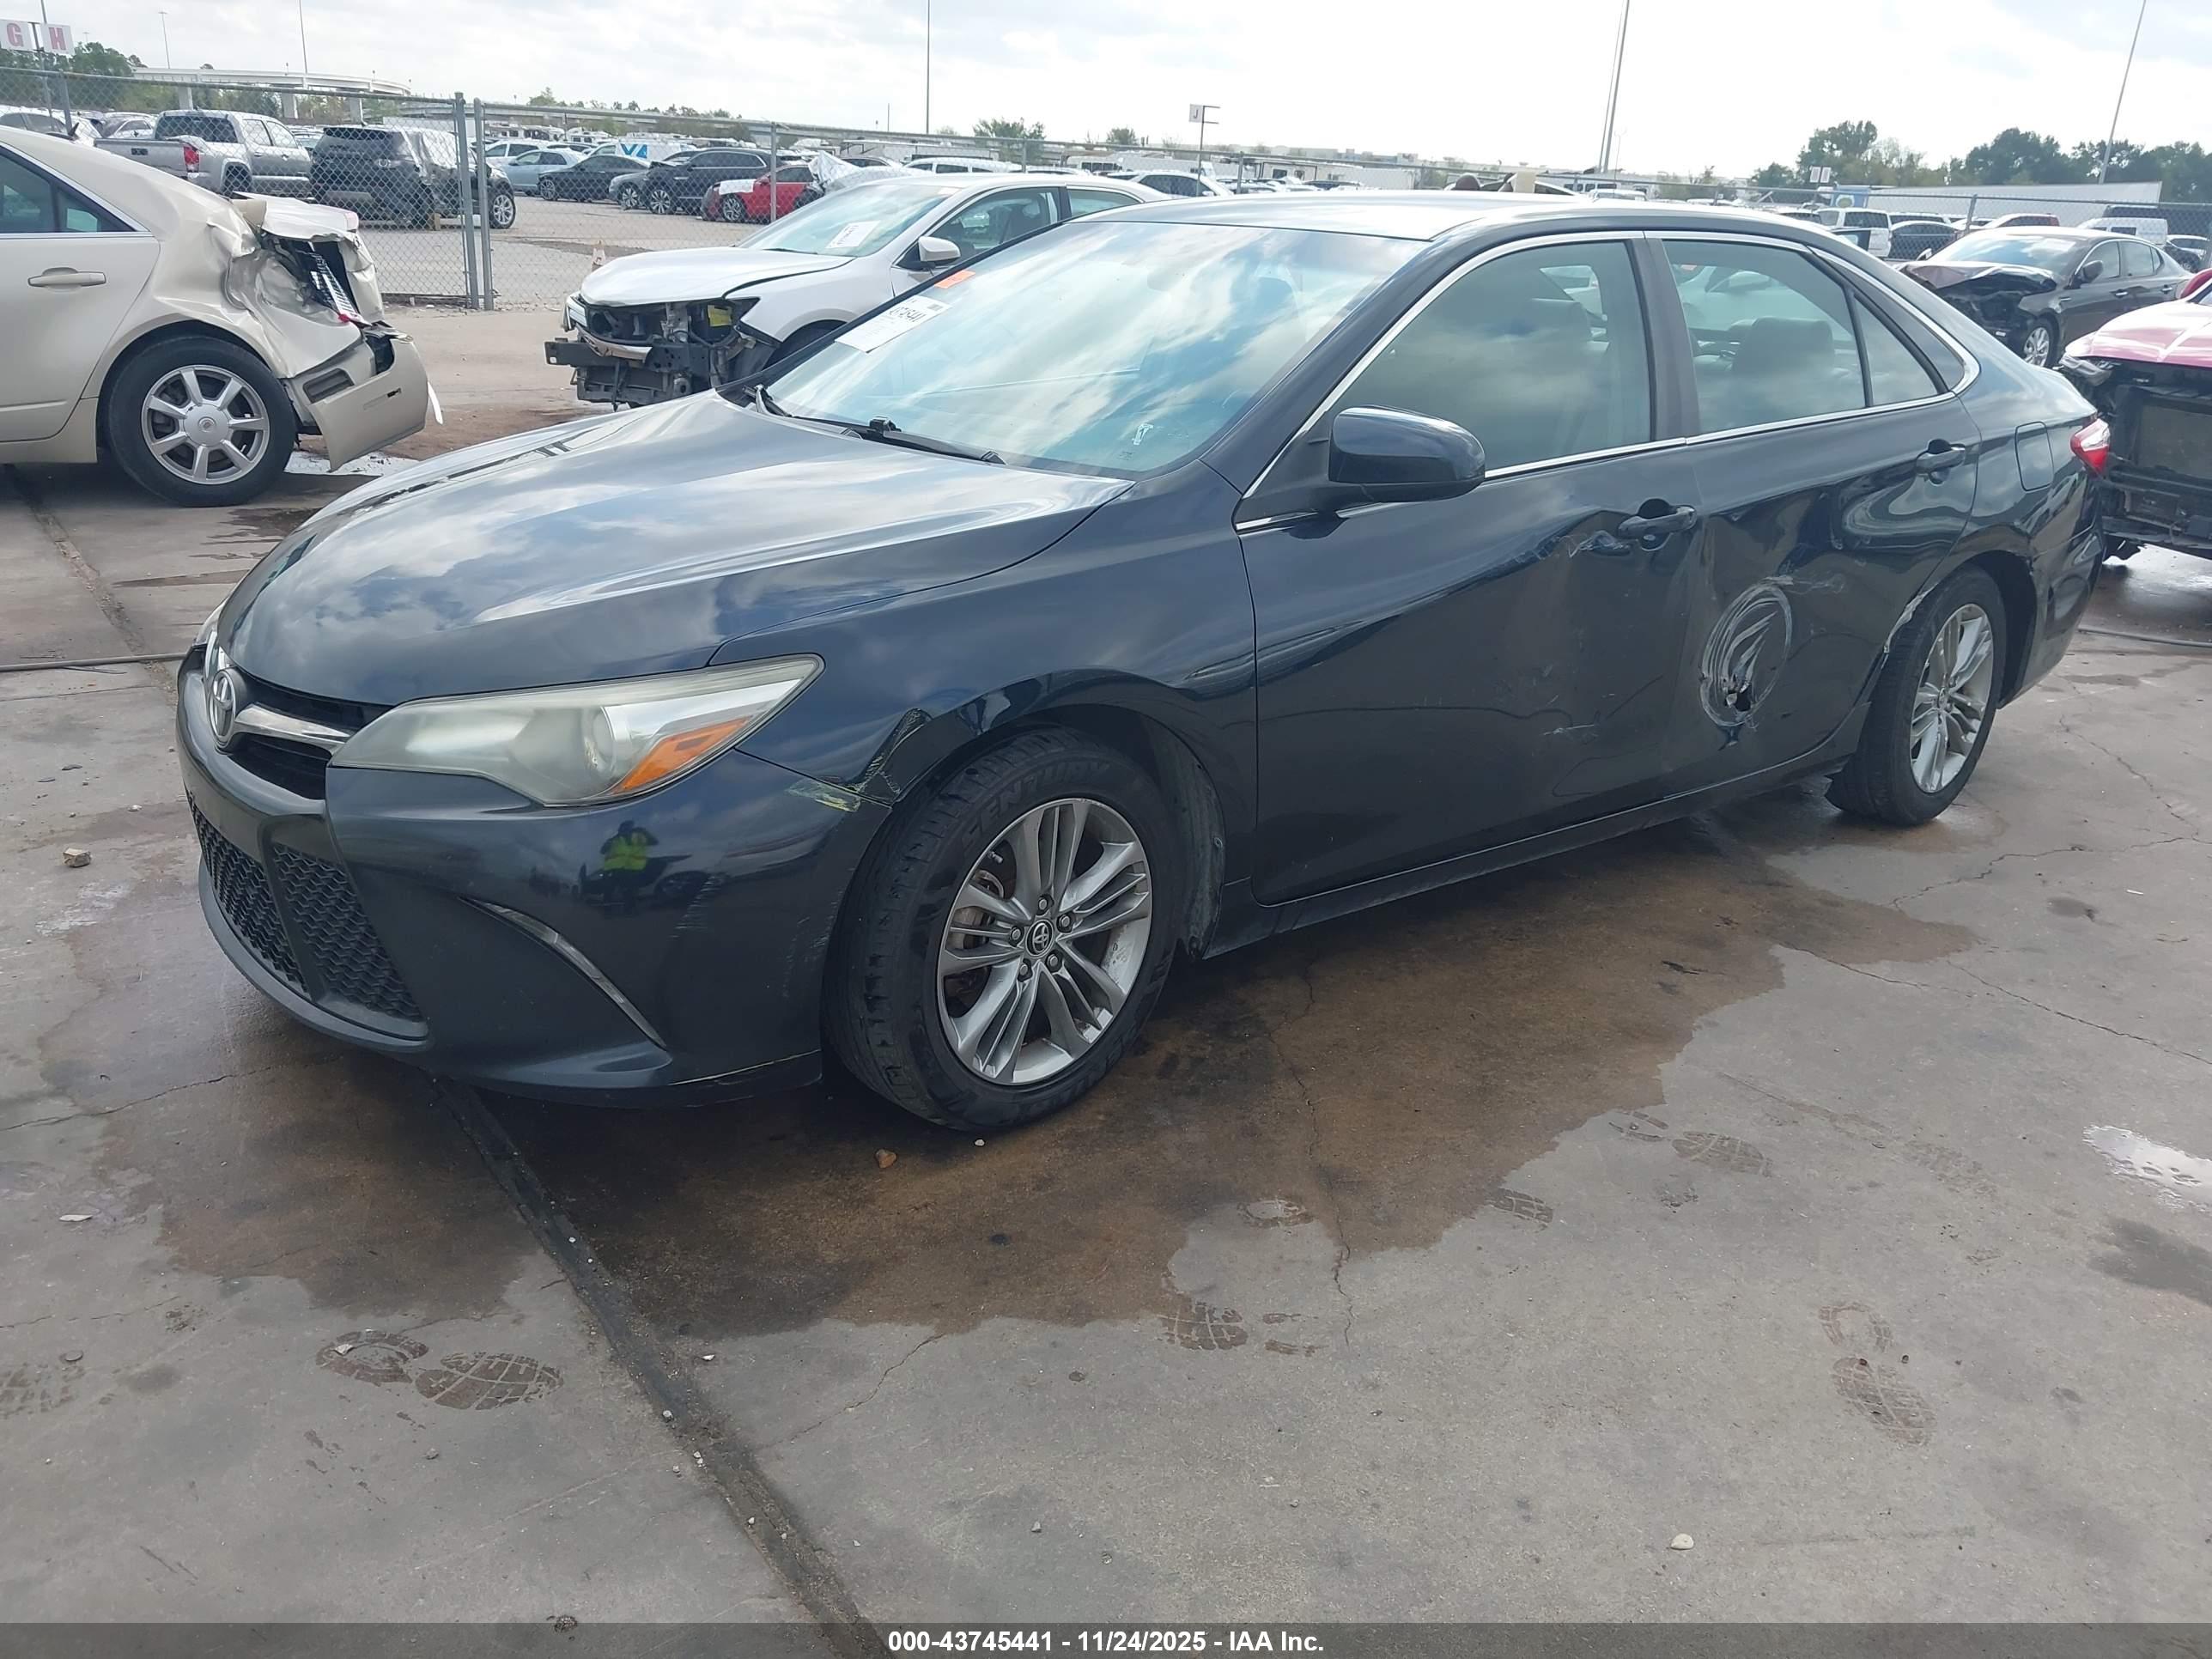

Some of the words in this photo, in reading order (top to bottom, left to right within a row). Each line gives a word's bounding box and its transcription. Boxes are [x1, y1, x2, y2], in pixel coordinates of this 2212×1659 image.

[7, 23, 24, 47] G
[48, 27, 66, 51] H
[1193, 109, 1199, 119] J
